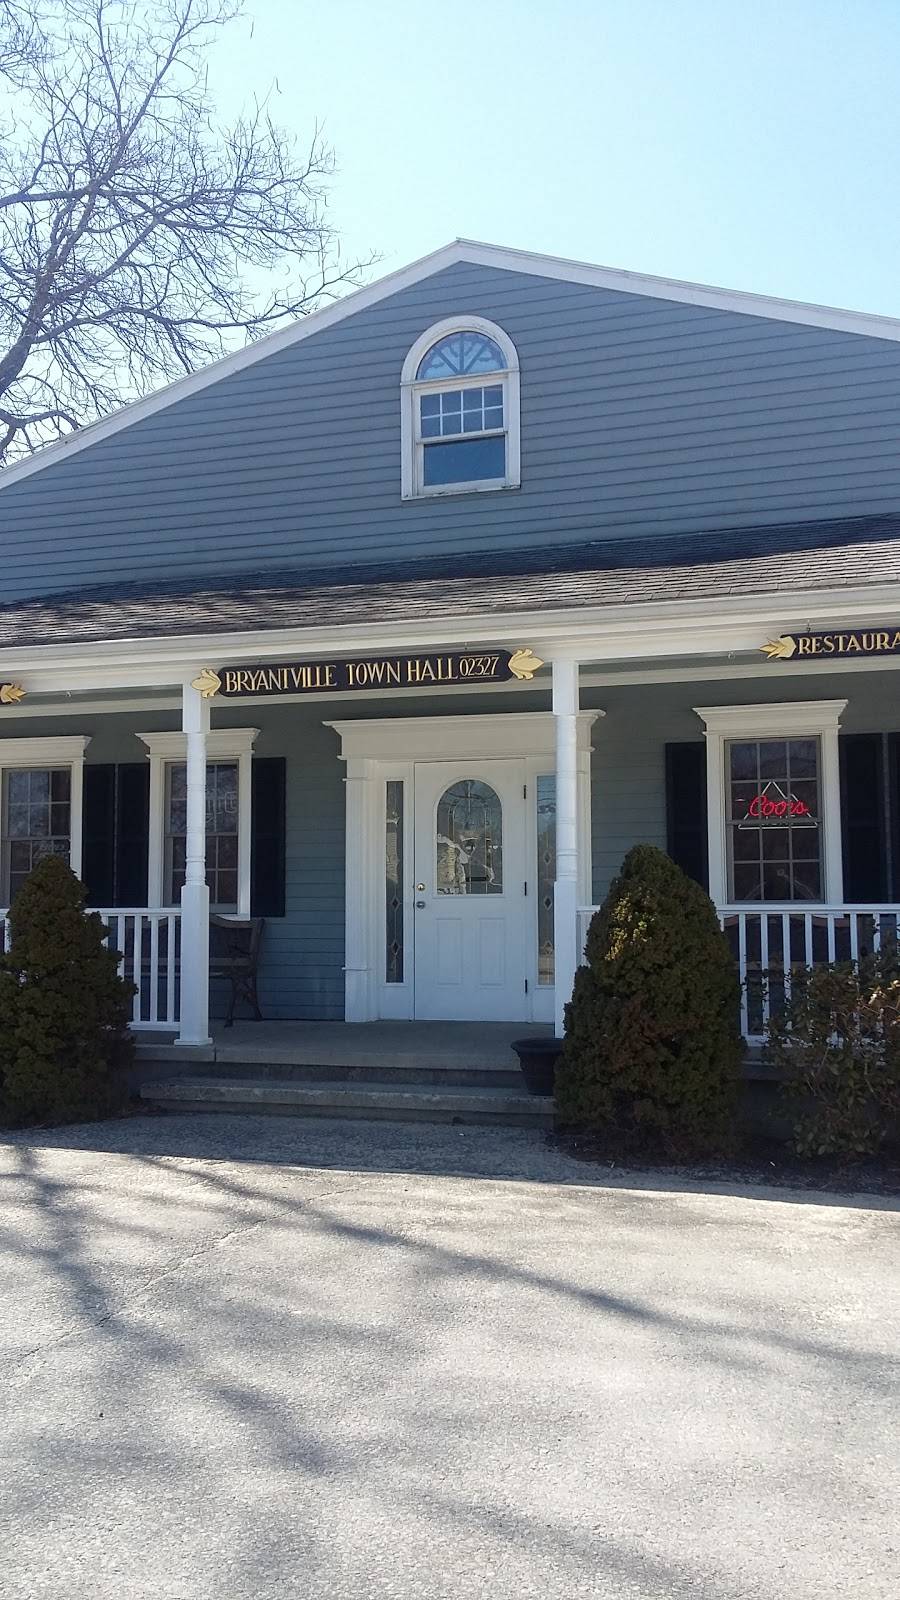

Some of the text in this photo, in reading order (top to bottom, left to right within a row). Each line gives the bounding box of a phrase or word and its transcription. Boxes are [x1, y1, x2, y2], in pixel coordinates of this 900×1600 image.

[225, 656, 500, 692] BRYANTVILLE TOWN HALL 02327
[748, 795, 809, 816] Coors
